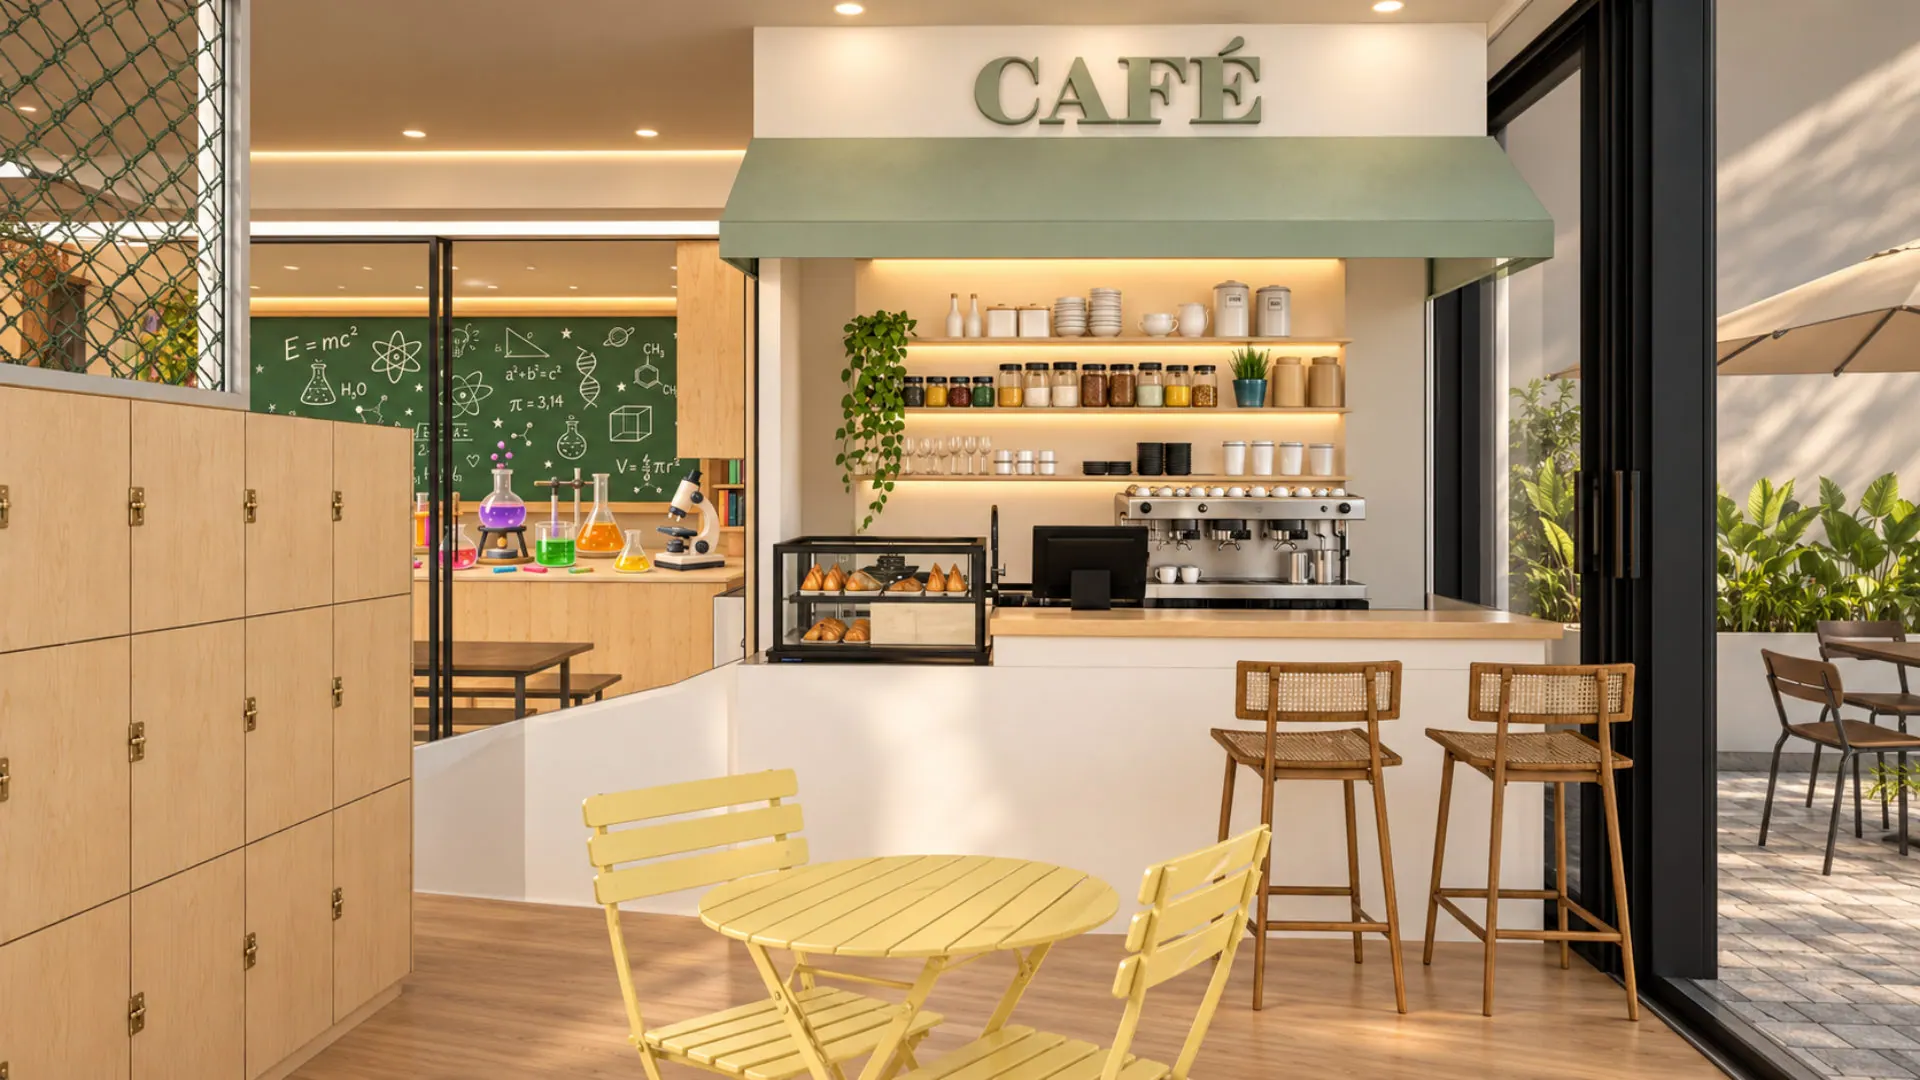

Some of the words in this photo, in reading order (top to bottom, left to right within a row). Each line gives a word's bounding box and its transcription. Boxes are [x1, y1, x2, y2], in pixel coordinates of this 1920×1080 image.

[974, 36, 1262, 126] CAFÉ
[285, 335, 300, 361] E
[306, 341, 317, 350] =
[509, 398, 523, 412] π
[537, 394, 564, 410] 3,14
